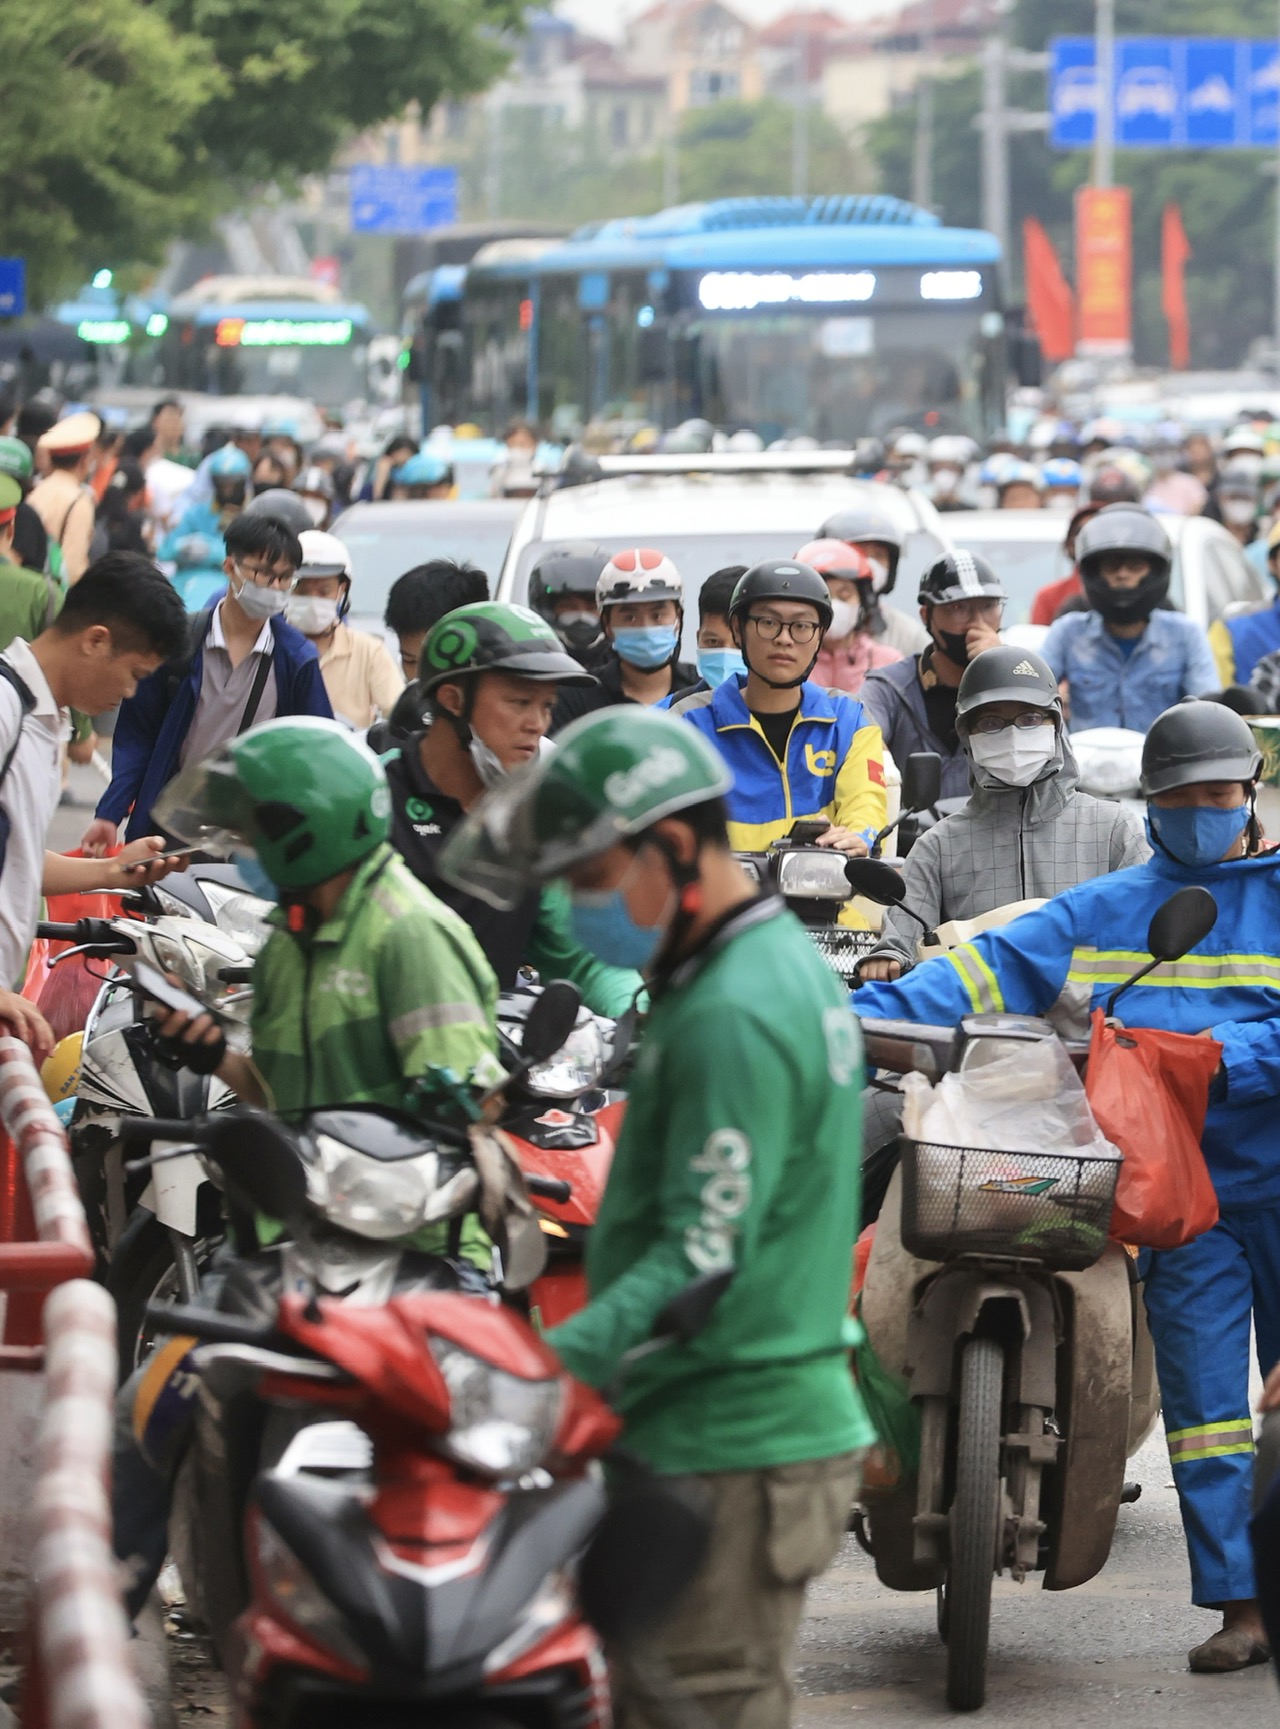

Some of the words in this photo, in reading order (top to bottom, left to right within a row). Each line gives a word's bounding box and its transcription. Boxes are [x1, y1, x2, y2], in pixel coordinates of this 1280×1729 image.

[1012, 669, 1040, 678] adidas
[804, 743, 836, 777] be
[684, 1127, 752, 1276] Grab
